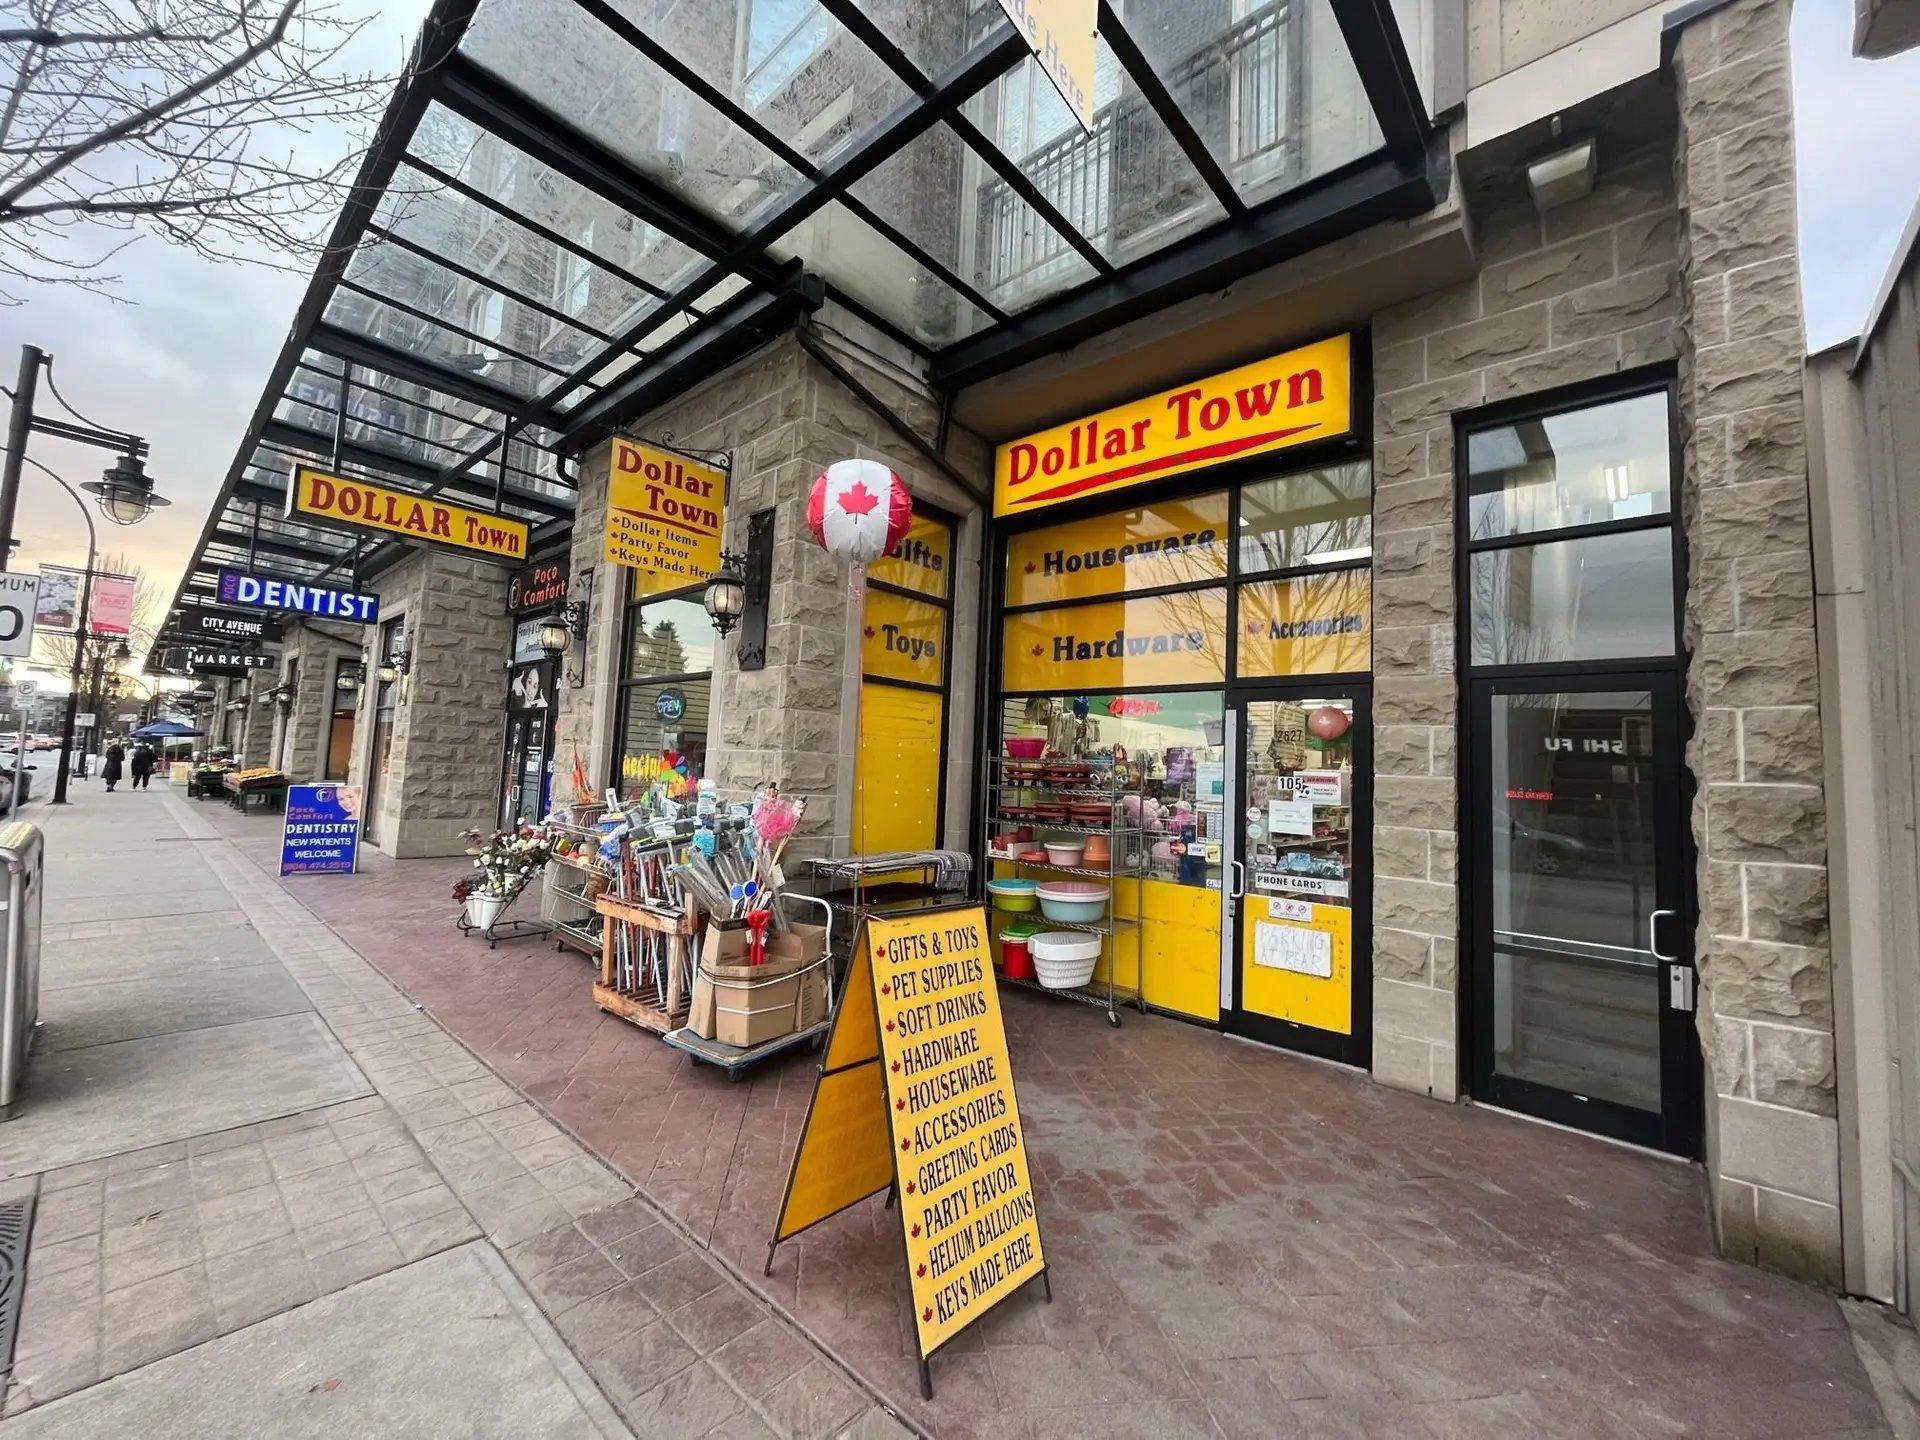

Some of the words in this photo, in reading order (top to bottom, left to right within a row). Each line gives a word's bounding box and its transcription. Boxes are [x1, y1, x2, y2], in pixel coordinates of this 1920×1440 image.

[1045, 28, 1085, 111] Here
[1008, 418, 1152, 486] Dollar
[1167, 367, 1325, 440] Town
[617, 445, 713, 498] Dollar
[308, 478, 451, 537] DOLLAR
[465, 515, 519, 553] Town
[645, 484, 718, 529] Town
[620, 532, 652, 553] Party
[658, 542, 690, 559] Favor
[621, 517, 661, 537] Dollar
[666, 528, 698, 546] Items
[619, 548, 648, 565] Keys
[654, 556, 685, 573] Made
[690, 564, 714, 580] Her
[1043, 527, 1216, 577] Houseware
[534, 566, 558, 585] Poco
[223, 574, 236, 600] POCO
[237, 577, 375, 619] DENTIST
[524, 580, 565, 606] Comfort
[202, 617, 225, 630] CITY
[226, 619, 263, 634] AVENUE
[1268, 610, 1363, 640] Accessories
[882, 624, 936, 660] Toys
[1053, 630, 1205, 662] Hardware
[194, 654, 268, 667] MARKET
[657, 698, 681, 713] OPEN
[1108, 696, 1161, 716] OPEN
[1276, 730, 1302, 742] 2627
[1280, 777, 1302, 791] 105
[286, 838, 308, 846] NEW
[310, 837, 351, 846] PATIENTS
[287, 824, 356, 834] DENTISTRY
[294, 849, 342, 858] WELCOME
[1257, 875, 1288, 886] PHONE
[1291, 878, 1322, 889] CARDS
[888, 934, 928, 963] GIFTS
[932, 932, 942, 955] &
[945, 926, 978, 953] TOYS
[1260, 926, 1324, 951] PARKING
[1261, 948, 1277, 962] AT
[1286, 950, 1321, 972] REAR
[892, 971, 918, 1000] PET
[922, 958, 983, 993] SUPPLIES
[898, 1004, 932, 1038] SOFT
[936, 991, 986, 1026] DRINKS
[902, 1028, 979, 1076] HARDWARE
[908, 1057, 996, 1114] HOUSEWARE
[915, 1094, 1006, 1154] ACCESSORIES
[918, 1142, 978, 1195] GREETING
[981, 1122, 1017, 1161] CARDS
[923, 1186, 968, 1238] PARTY
[973, 1162, 1017, 1209] FAVOR
[929, 1225, 976, 1279] HELIUM
[977, 1191, 1033, 1248] BALLOONS
[935, 1277, 968, 1325] KEYS
[970, 1251, 1004, 1301] MADE
[1004, 1233, 1034, 1276] HERE
